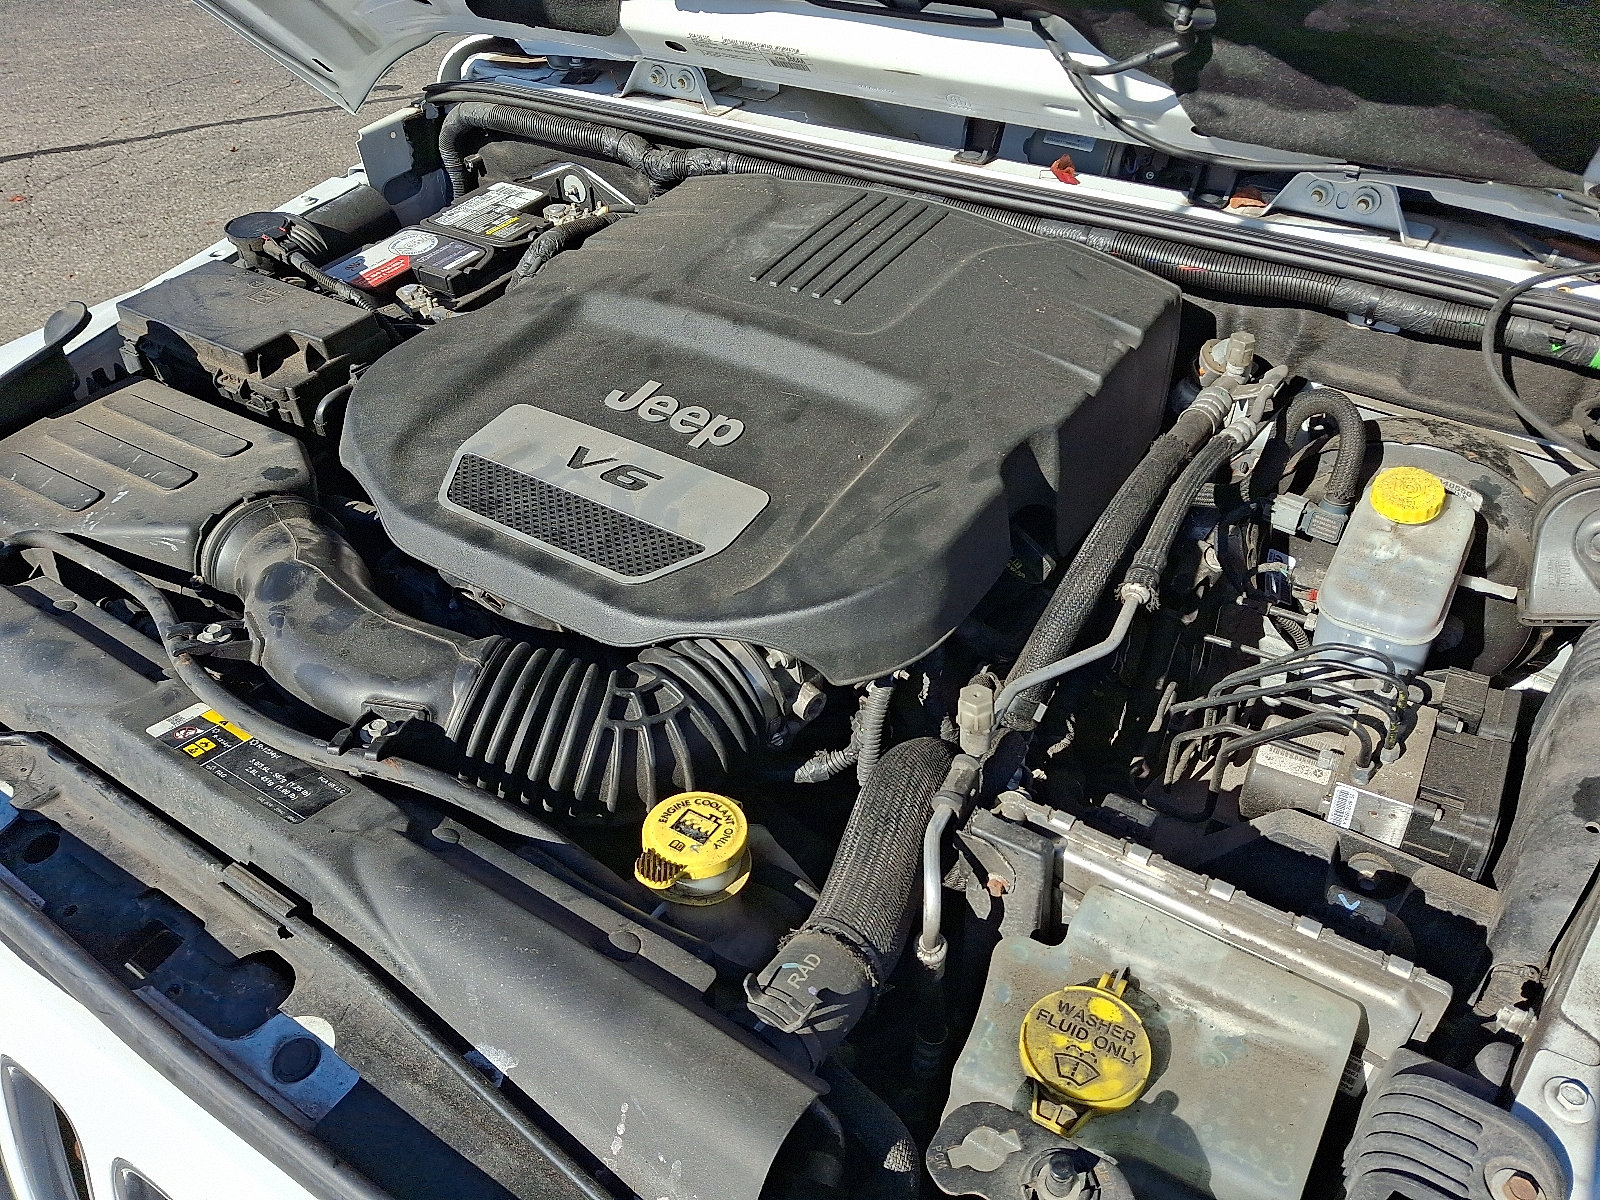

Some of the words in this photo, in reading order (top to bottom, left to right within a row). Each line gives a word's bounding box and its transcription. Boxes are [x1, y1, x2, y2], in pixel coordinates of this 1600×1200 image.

[604, 379, 745, 448] Jeep
[565, 445, 664, 492] V6
[658, 799, 692, 824] ENGINE
[694, 798, 735, 826] COOLANT
[713, 828, 734, 850] ONLY
[786, 953, 821, 990] RAD
[1036, 1008, 1089, 1041] FLUID
[1094, 1035, 1144, 1067] ONLY
[1058, 999, 1136, 1047] WASHER
